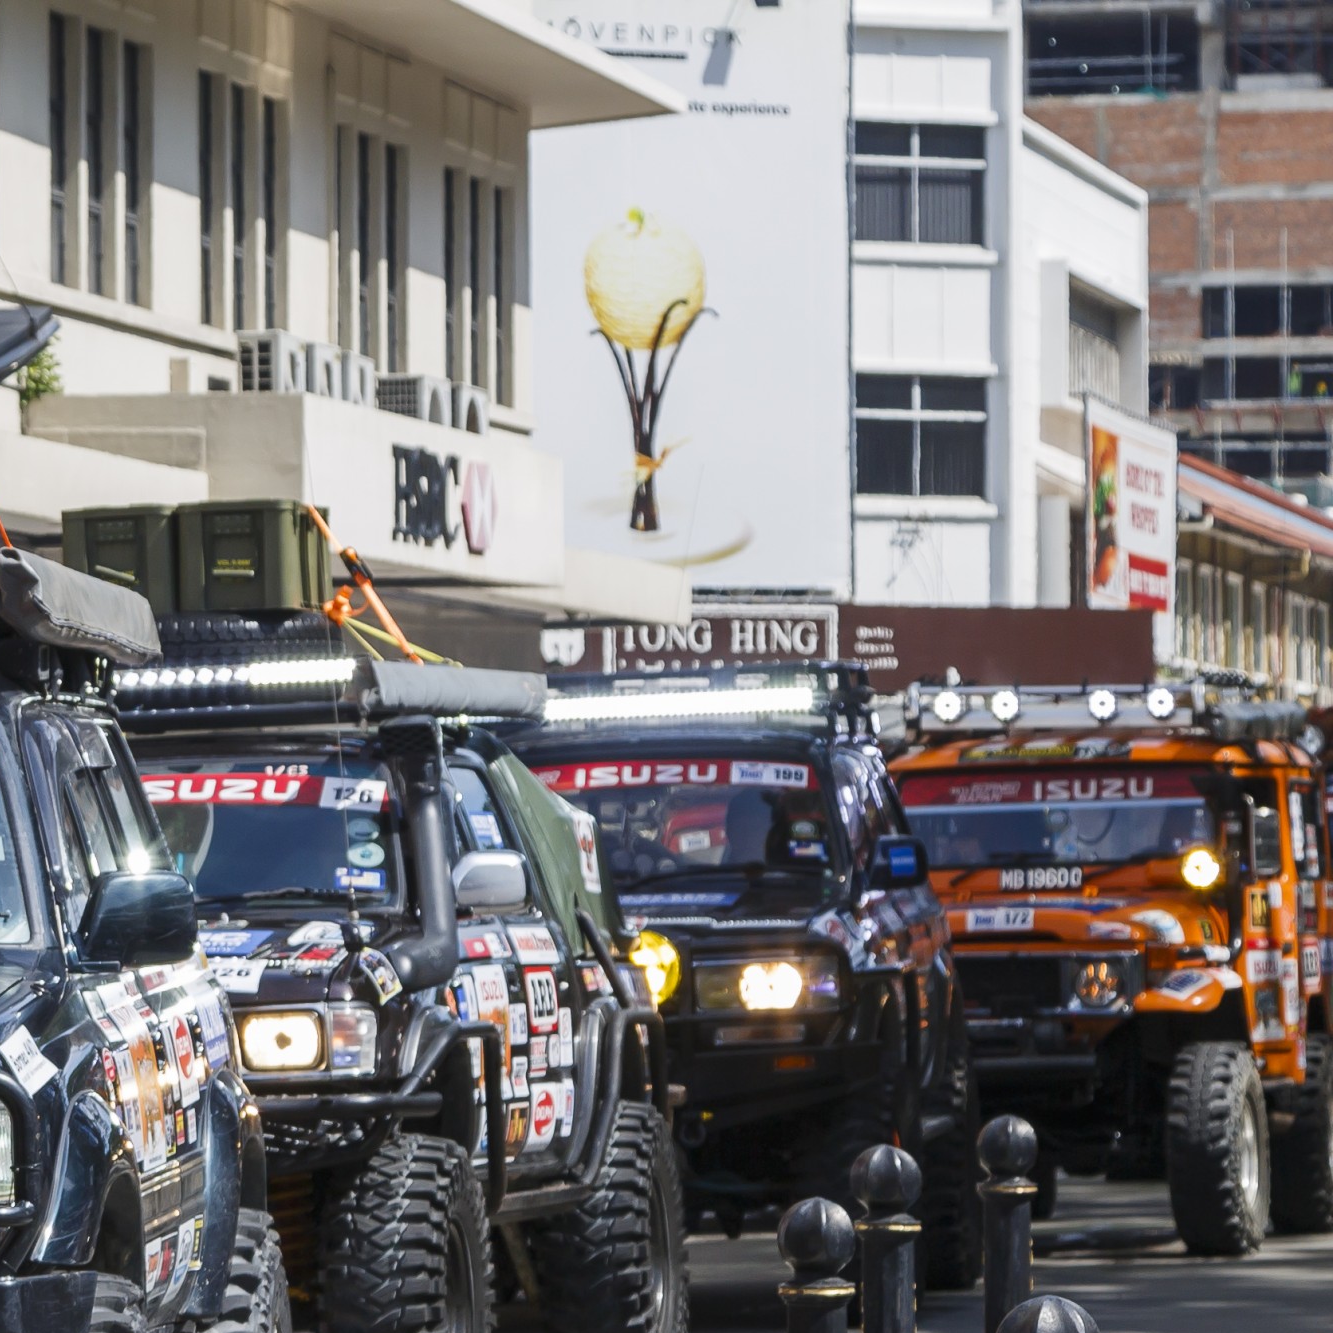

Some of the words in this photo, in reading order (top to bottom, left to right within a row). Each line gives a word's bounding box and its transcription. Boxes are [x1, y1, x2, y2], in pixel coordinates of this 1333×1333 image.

[712, 101, 790, 116] experience
[731, 620, 818, 654] HING
[574, 763, 718, 788] ISUZU
[141, 779, 300, 801] SUZU
[1034, 777, 1154, 801] ISUZU
[482, 980, 504, 1001] ISUZU
[531, 977, 555, 1018] ARB
